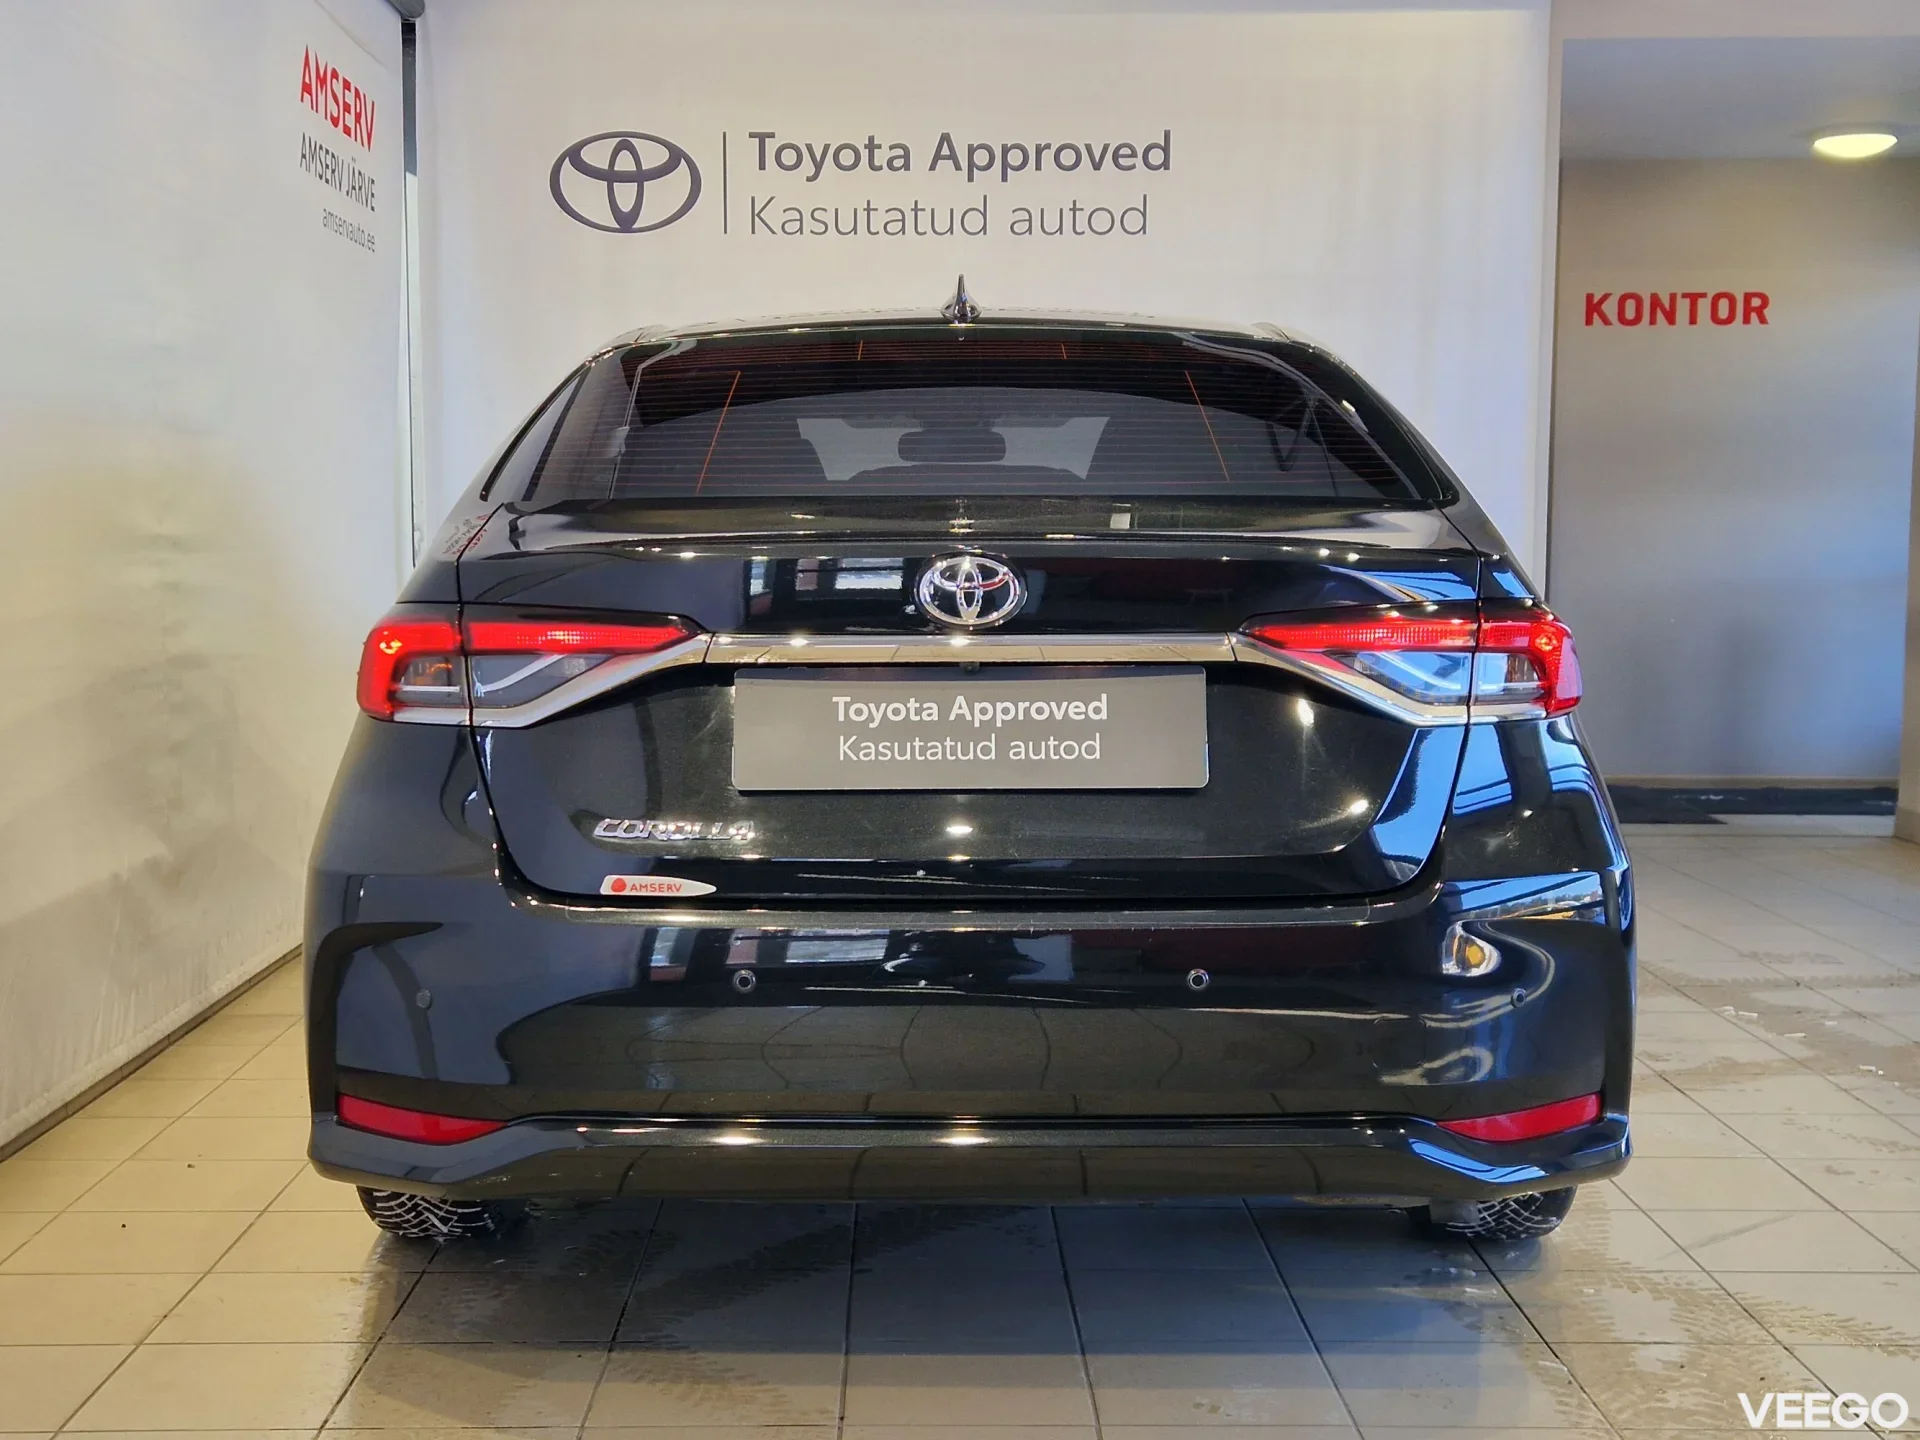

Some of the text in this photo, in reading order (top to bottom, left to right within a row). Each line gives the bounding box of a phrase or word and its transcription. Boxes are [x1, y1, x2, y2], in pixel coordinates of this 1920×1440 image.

[300, 44, 375, 152] AMSERV
[300, 131, 375, 212] AMSERV JÄRVE
[748, 130, 1172, 182] Toyota Approved
[322, 207, 375, 252] amservauto.ee
[750, 194, 1148, 236] Kasutatud autod
[1584, 291, 1770, 327] KONTOR
[832, 693, 1108, 727] Toyota Approved
[839, 733, 1101, 761] Kasutatud autod
[593, 818, 755, 841] COROLLA
[629, 883, 683, 893] AMSERV
